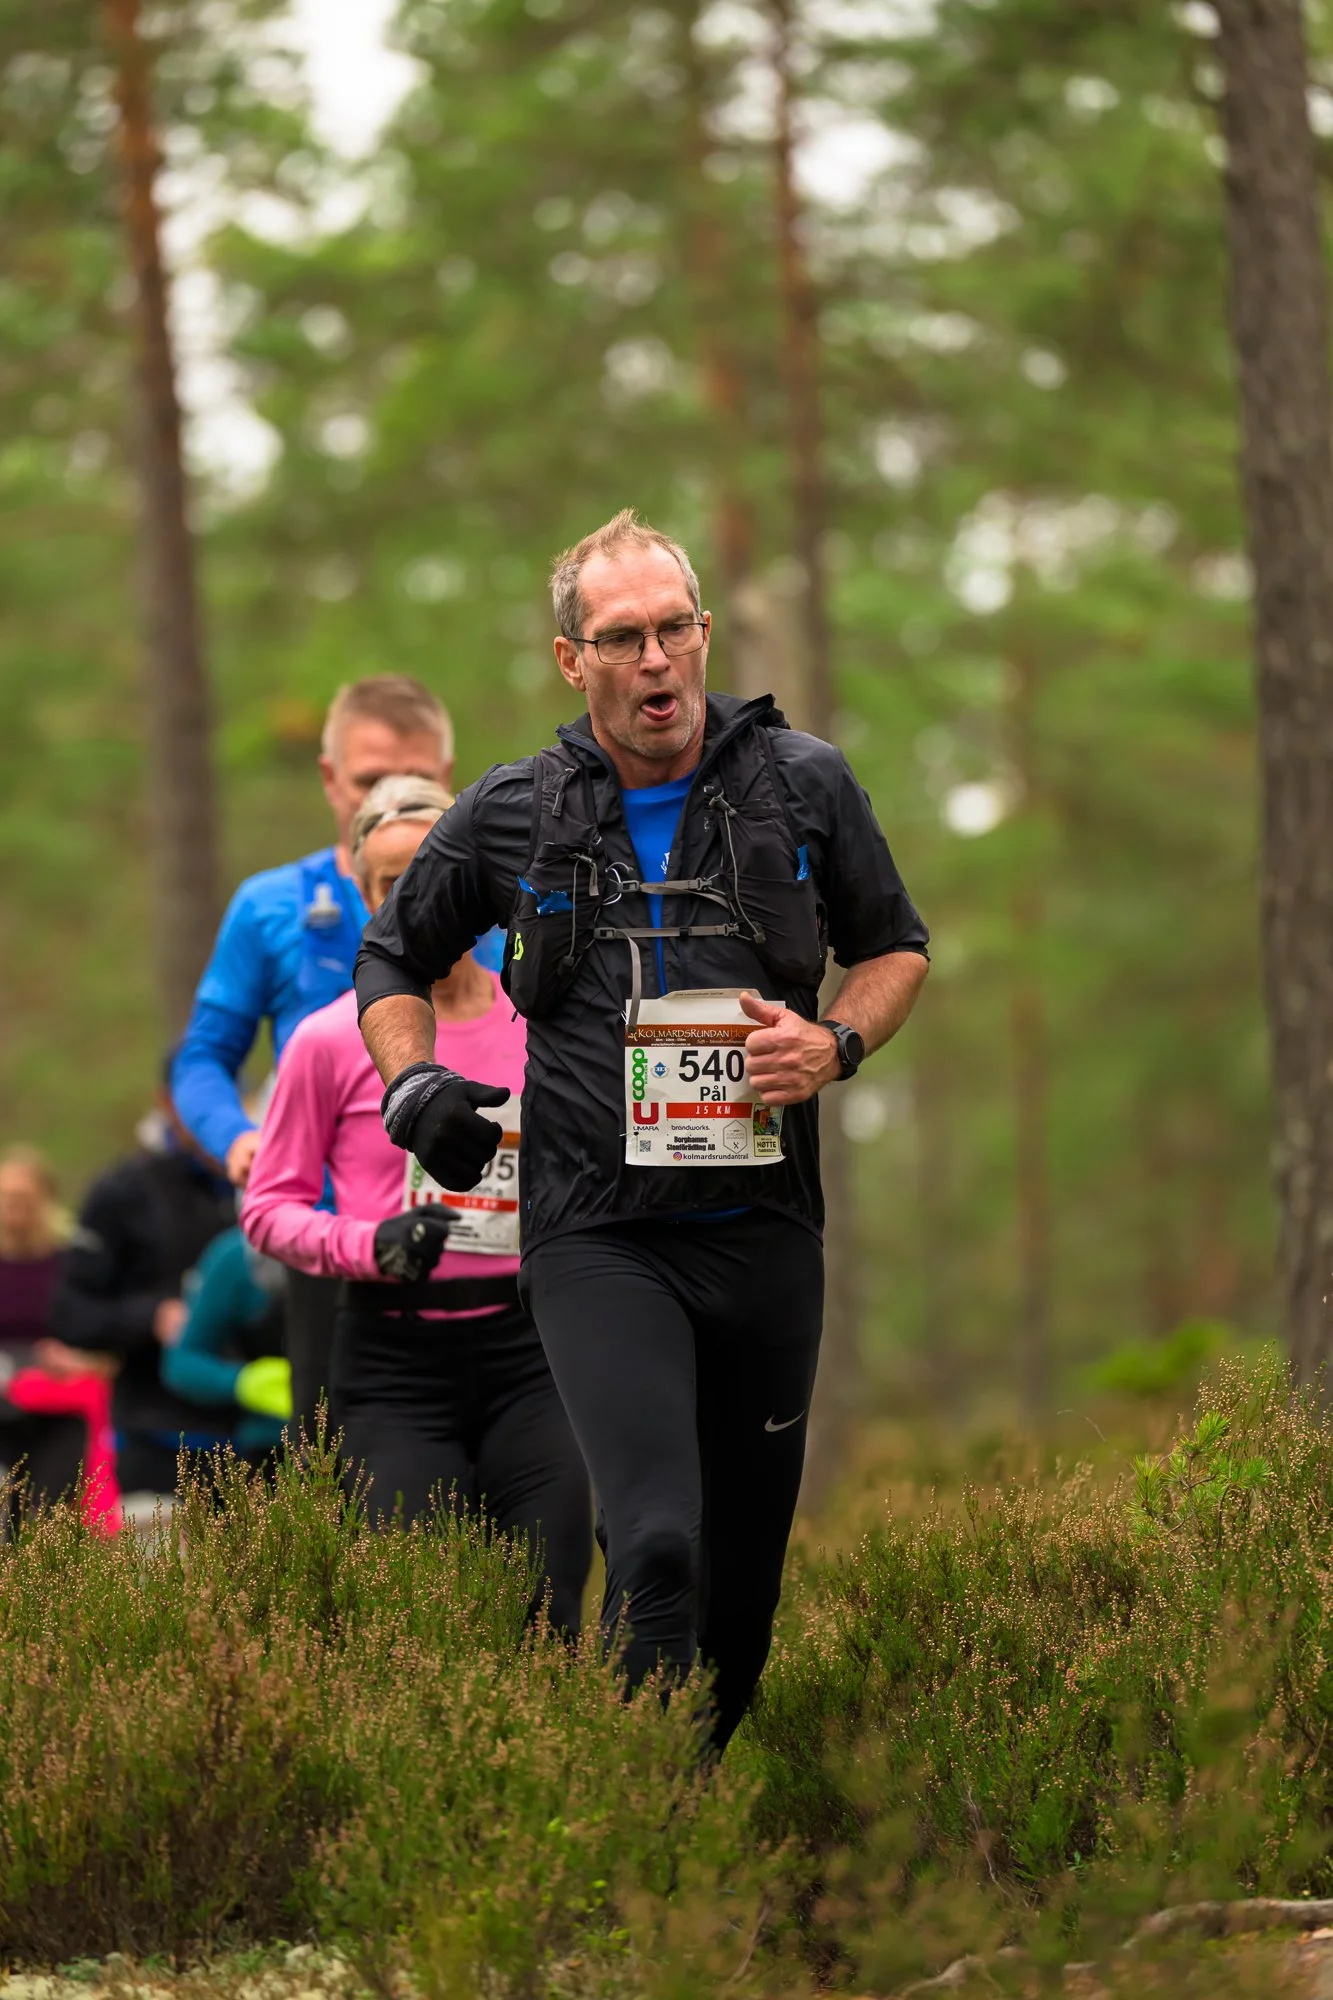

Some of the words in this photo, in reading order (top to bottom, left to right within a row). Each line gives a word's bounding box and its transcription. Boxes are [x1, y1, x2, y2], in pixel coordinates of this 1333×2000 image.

[632, 1048, 648, 1101] coop
[679, 1050, 745, 1083] 540
[700, 1085, 727, 1101] Pål
[696, 1105, 709, 1115] 15
[716, 1105, 731, 1115] KM
